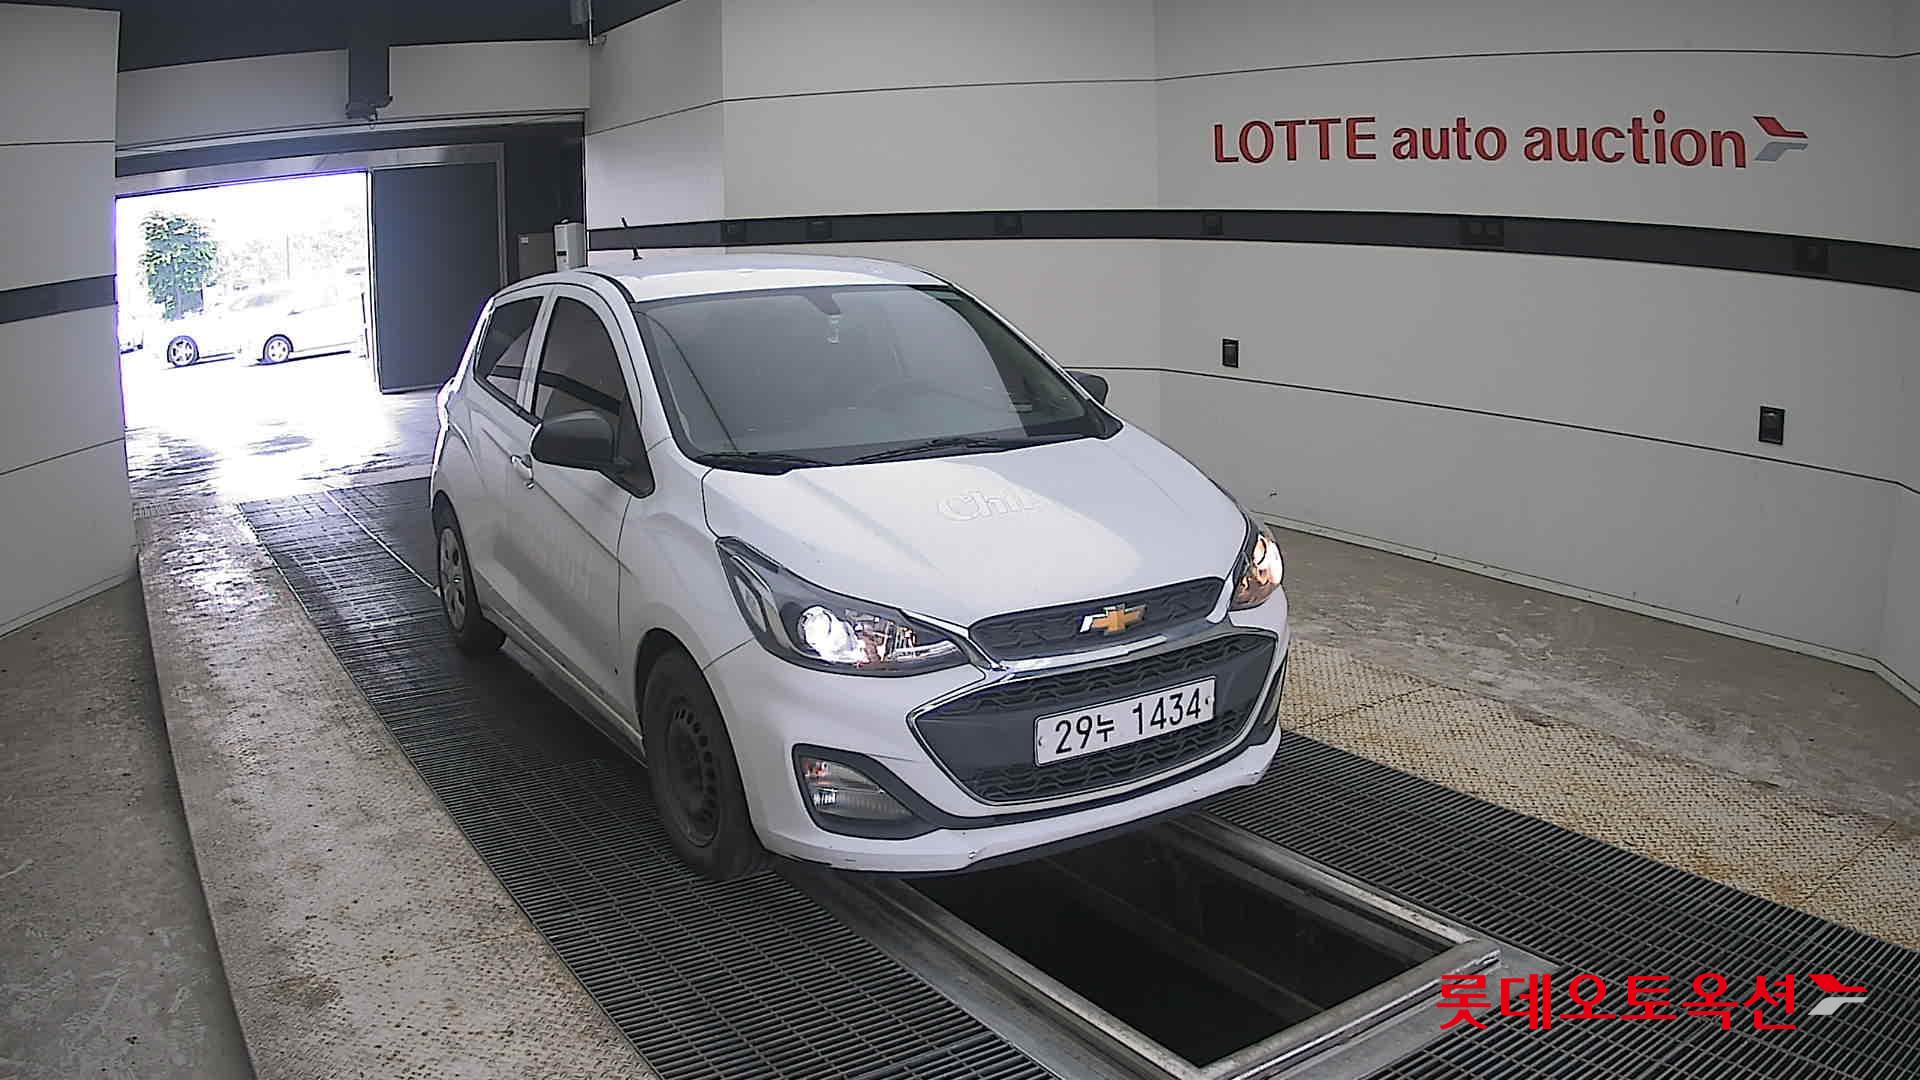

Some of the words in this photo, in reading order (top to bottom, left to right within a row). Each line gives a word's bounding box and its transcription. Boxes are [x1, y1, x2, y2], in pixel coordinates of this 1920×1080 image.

[1213, 116, 1376, 163] LOTTE
[1391, 117, 1508, 162] auto
[1523, 110, 1746, 168] auction
[1055, 714, 1115, 754] 29누
[1132, 688, 1201, 735] 1434
